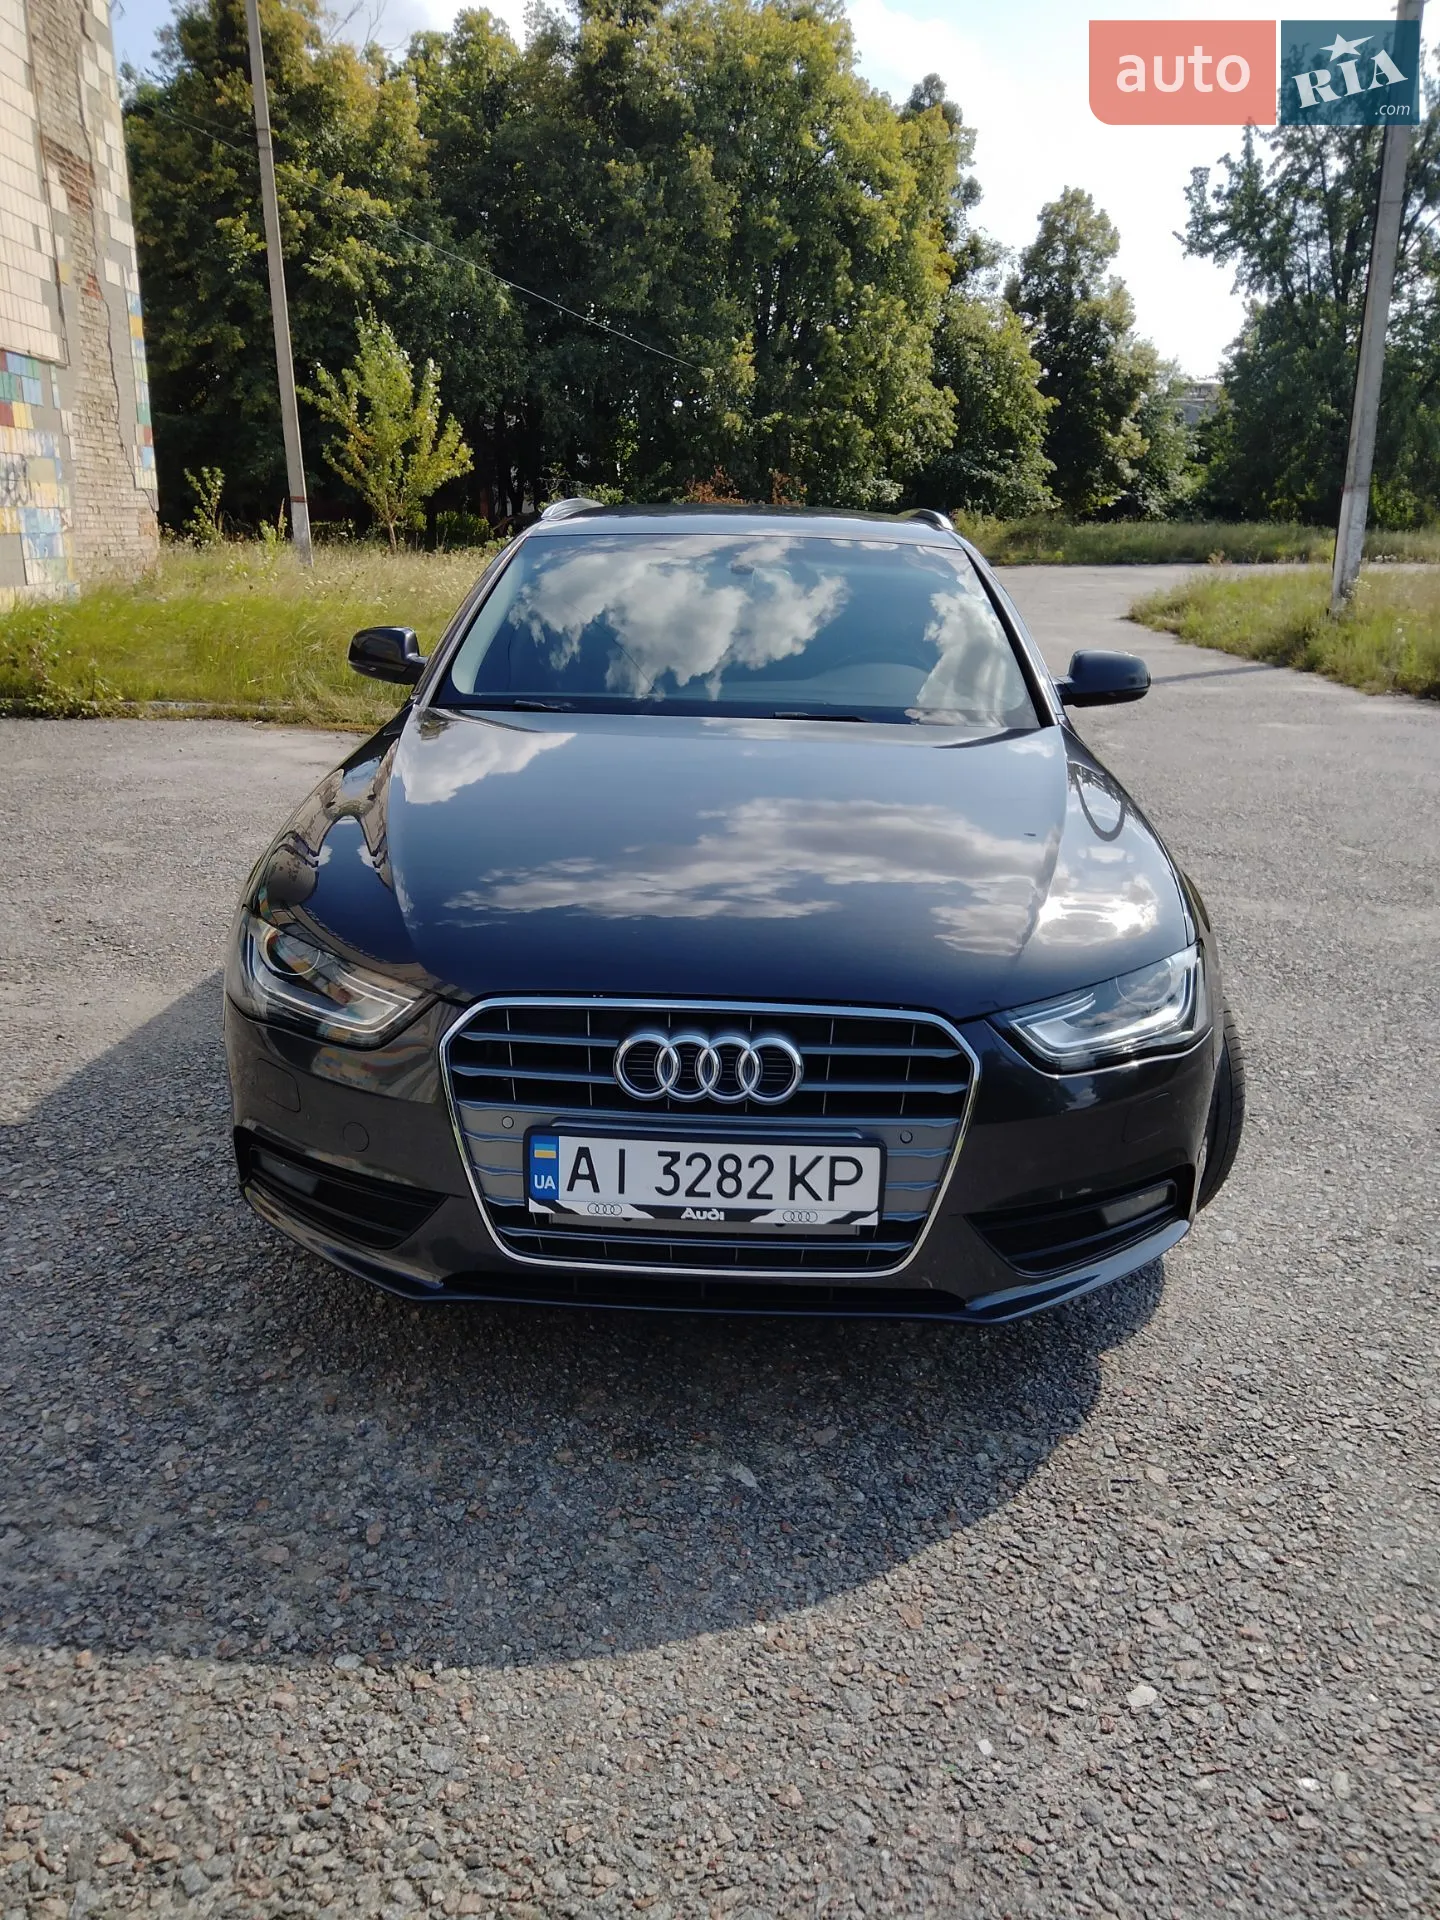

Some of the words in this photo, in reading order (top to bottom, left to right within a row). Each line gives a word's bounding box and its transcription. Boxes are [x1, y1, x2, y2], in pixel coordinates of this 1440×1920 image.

[567, 1146, 626, 1195] AI
[655, 1150, 774, 1201] 3282
[788, 1155, 863, 1202] KP
[534, 1175, 556, 1190] UA
[681, 1207, 725, 1221] Audi
